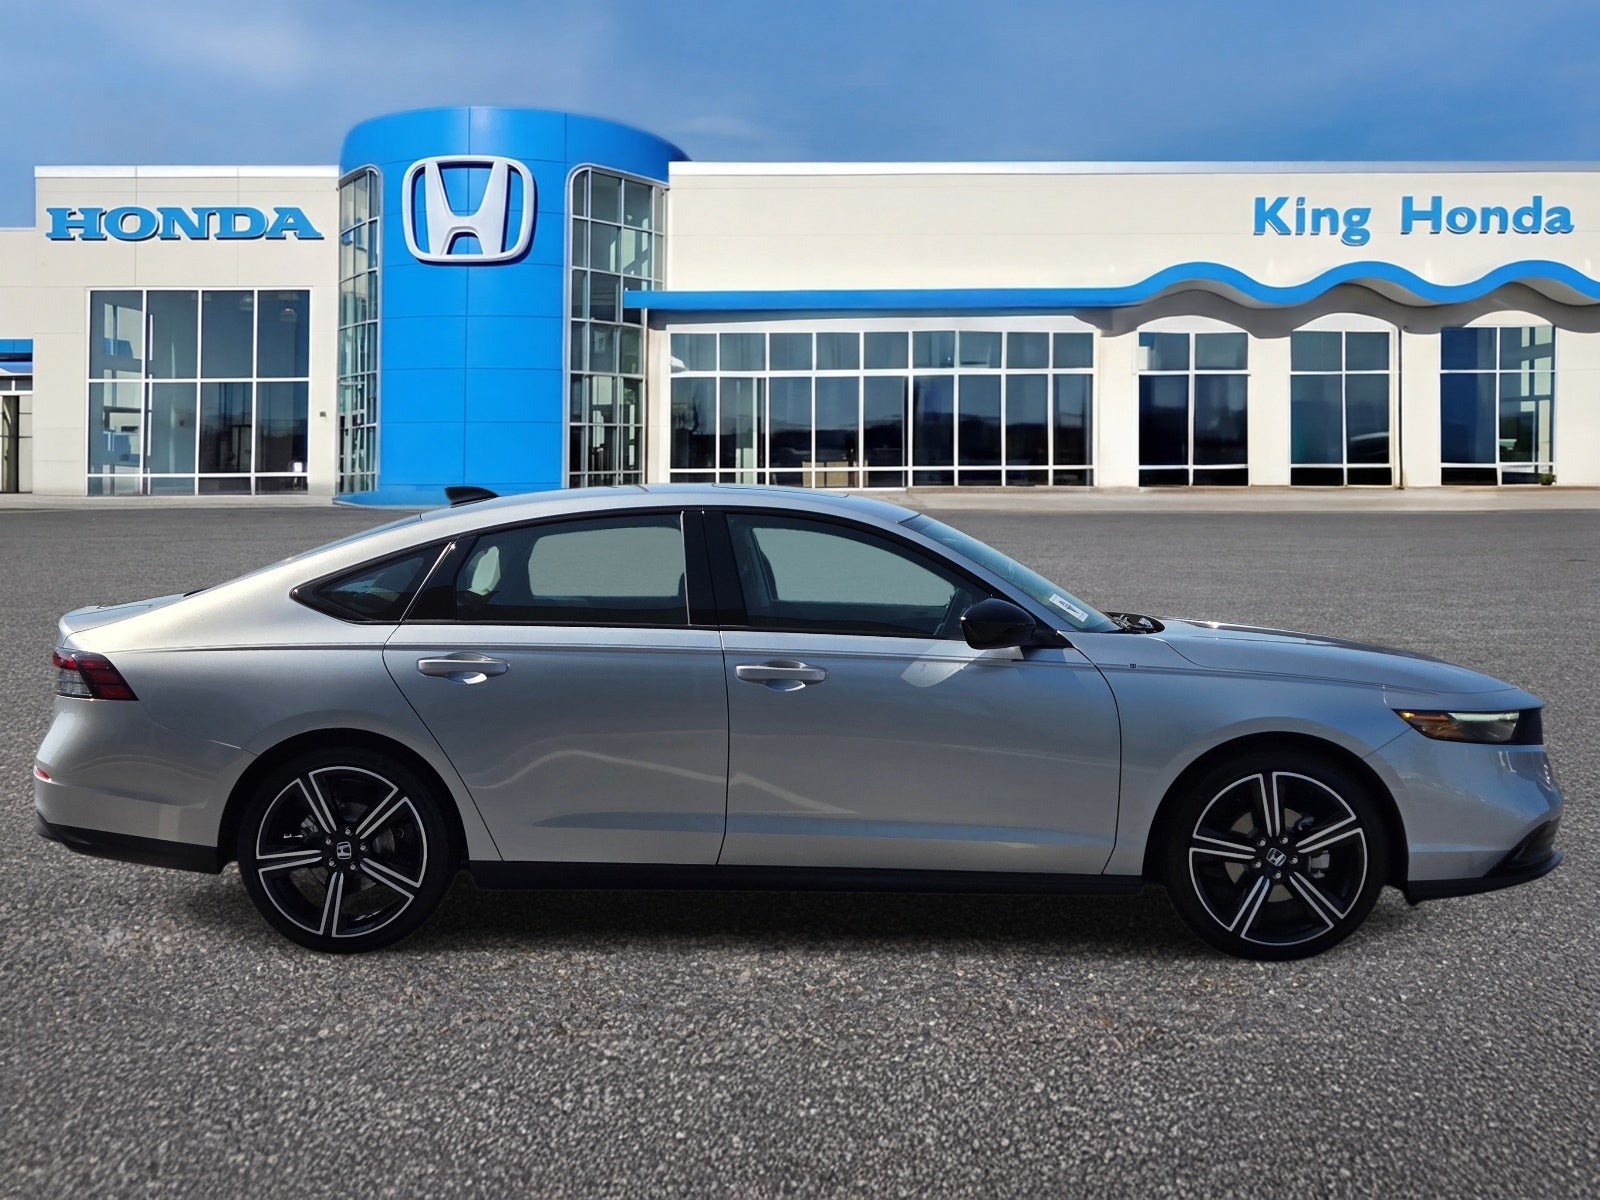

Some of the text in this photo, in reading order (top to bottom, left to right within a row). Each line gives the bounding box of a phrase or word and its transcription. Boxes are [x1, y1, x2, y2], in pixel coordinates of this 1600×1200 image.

[45, 206, 324, 241] HONDA
[1253, 195, 1575, 246] King Honda
